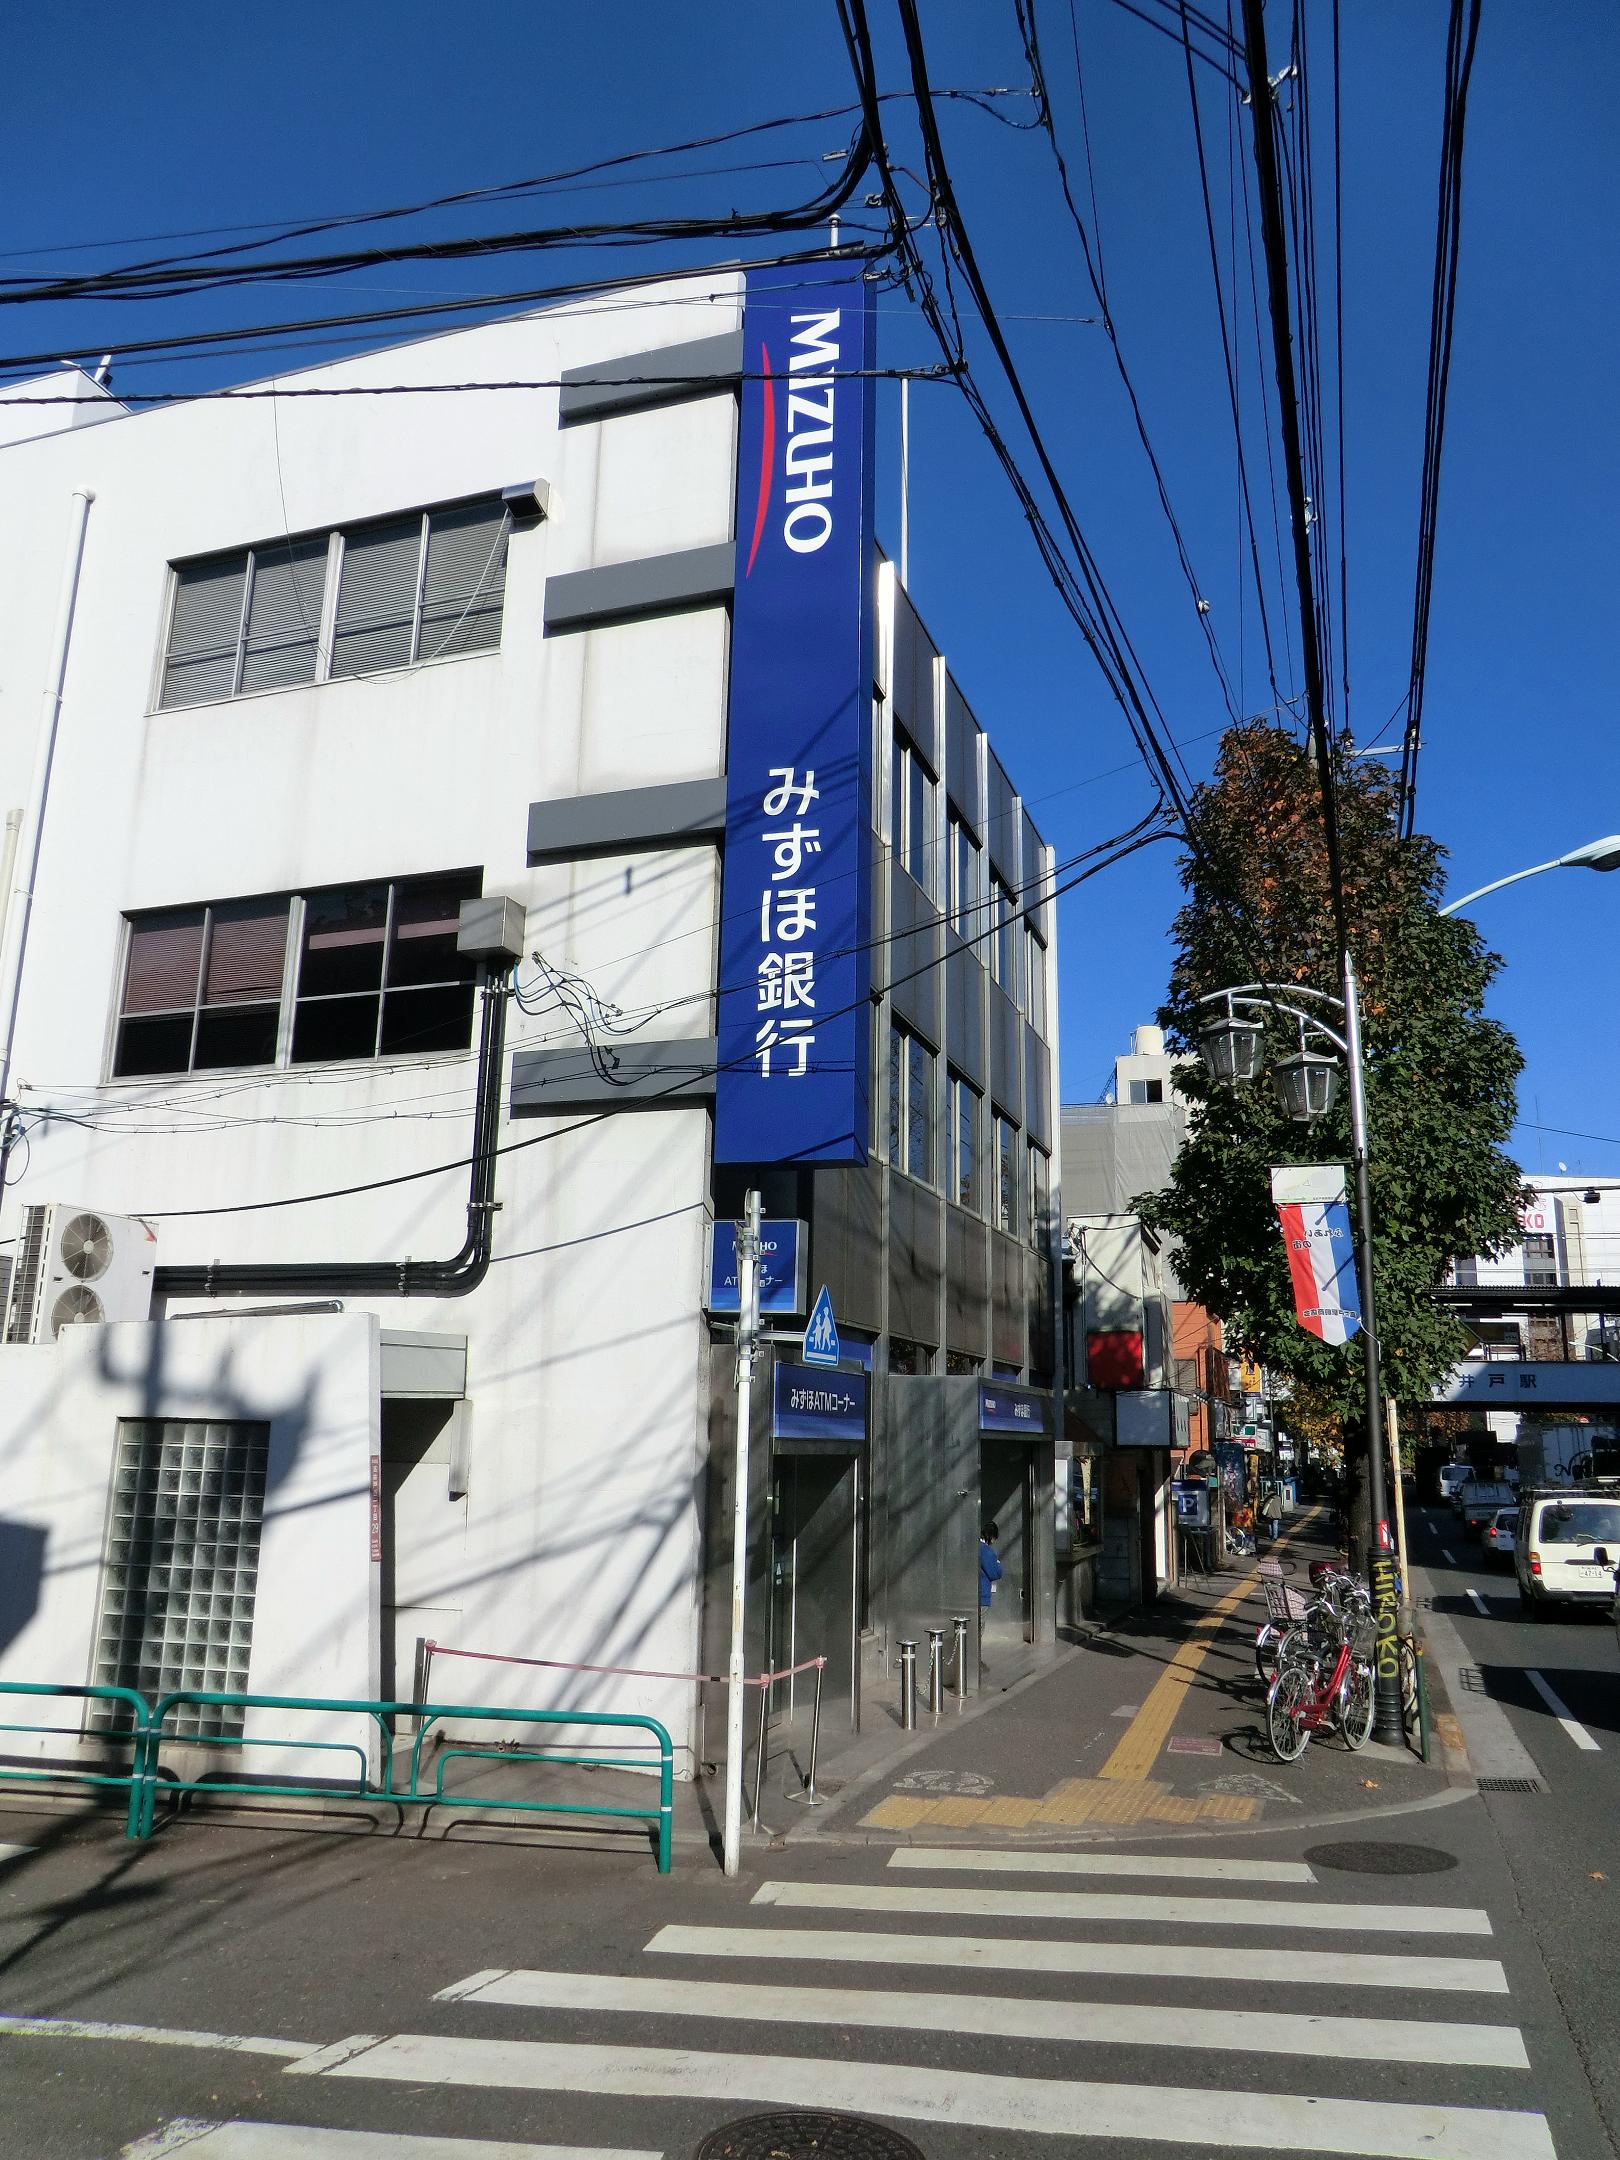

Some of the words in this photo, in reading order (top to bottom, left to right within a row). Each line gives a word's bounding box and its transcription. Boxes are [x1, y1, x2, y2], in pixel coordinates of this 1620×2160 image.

[784, 308, 840, 553] MIZUHO
[755, 767, 822, 1078] みずほ銀行
[1431, 1373, 1537, 1390] 井戸駅
[790, 1388, 856, 1413] みずほATMコーナー
[1183, 1497, 1195, 1513] P
